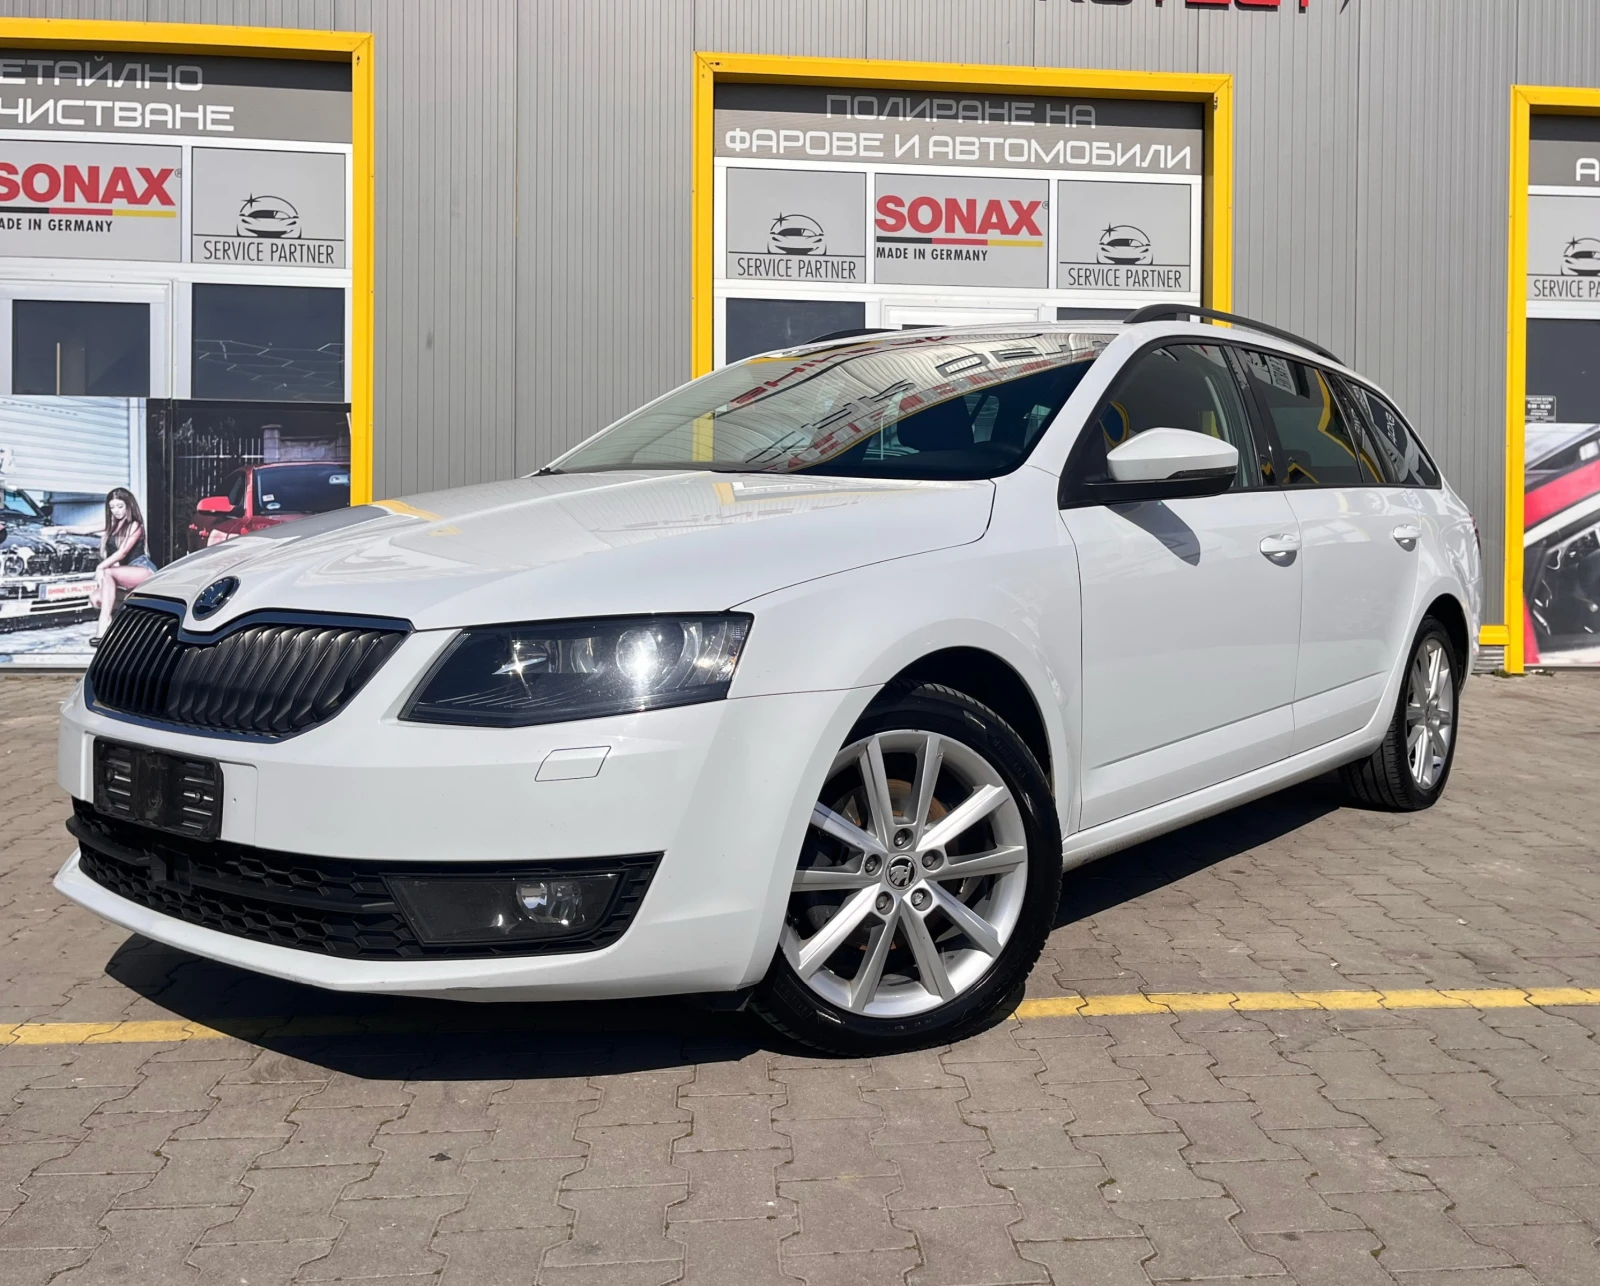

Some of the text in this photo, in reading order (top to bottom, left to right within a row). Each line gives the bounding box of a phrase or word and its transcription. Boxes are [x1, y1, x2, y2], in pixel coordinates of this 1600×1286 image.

[0, 97, 235, 132] ЧИСТВАНЕ
[826, 94, 1097, 129] ПОЛИРАНЕ НА
[725, 127, 1192, 170] ФАРОВЕ И АВТОМОБИЛИ
[0, 162, 176, 206] SONAX
[28, 218, 42, 231] IN
[48, 219, 113, 233] GERMANY
[875, 194, 1044, 236] SONAX
[203, 240, 335, 265] SERVICE PARTNER
[876, 247, 988, 262] MADE IN GERMANY
[737, 257, 857, 280] SERVICE PARTNER
[1068, 267, 1182, 288] SERVICE PARTNER
[1533, 279, 1584, 298] SERVICE
